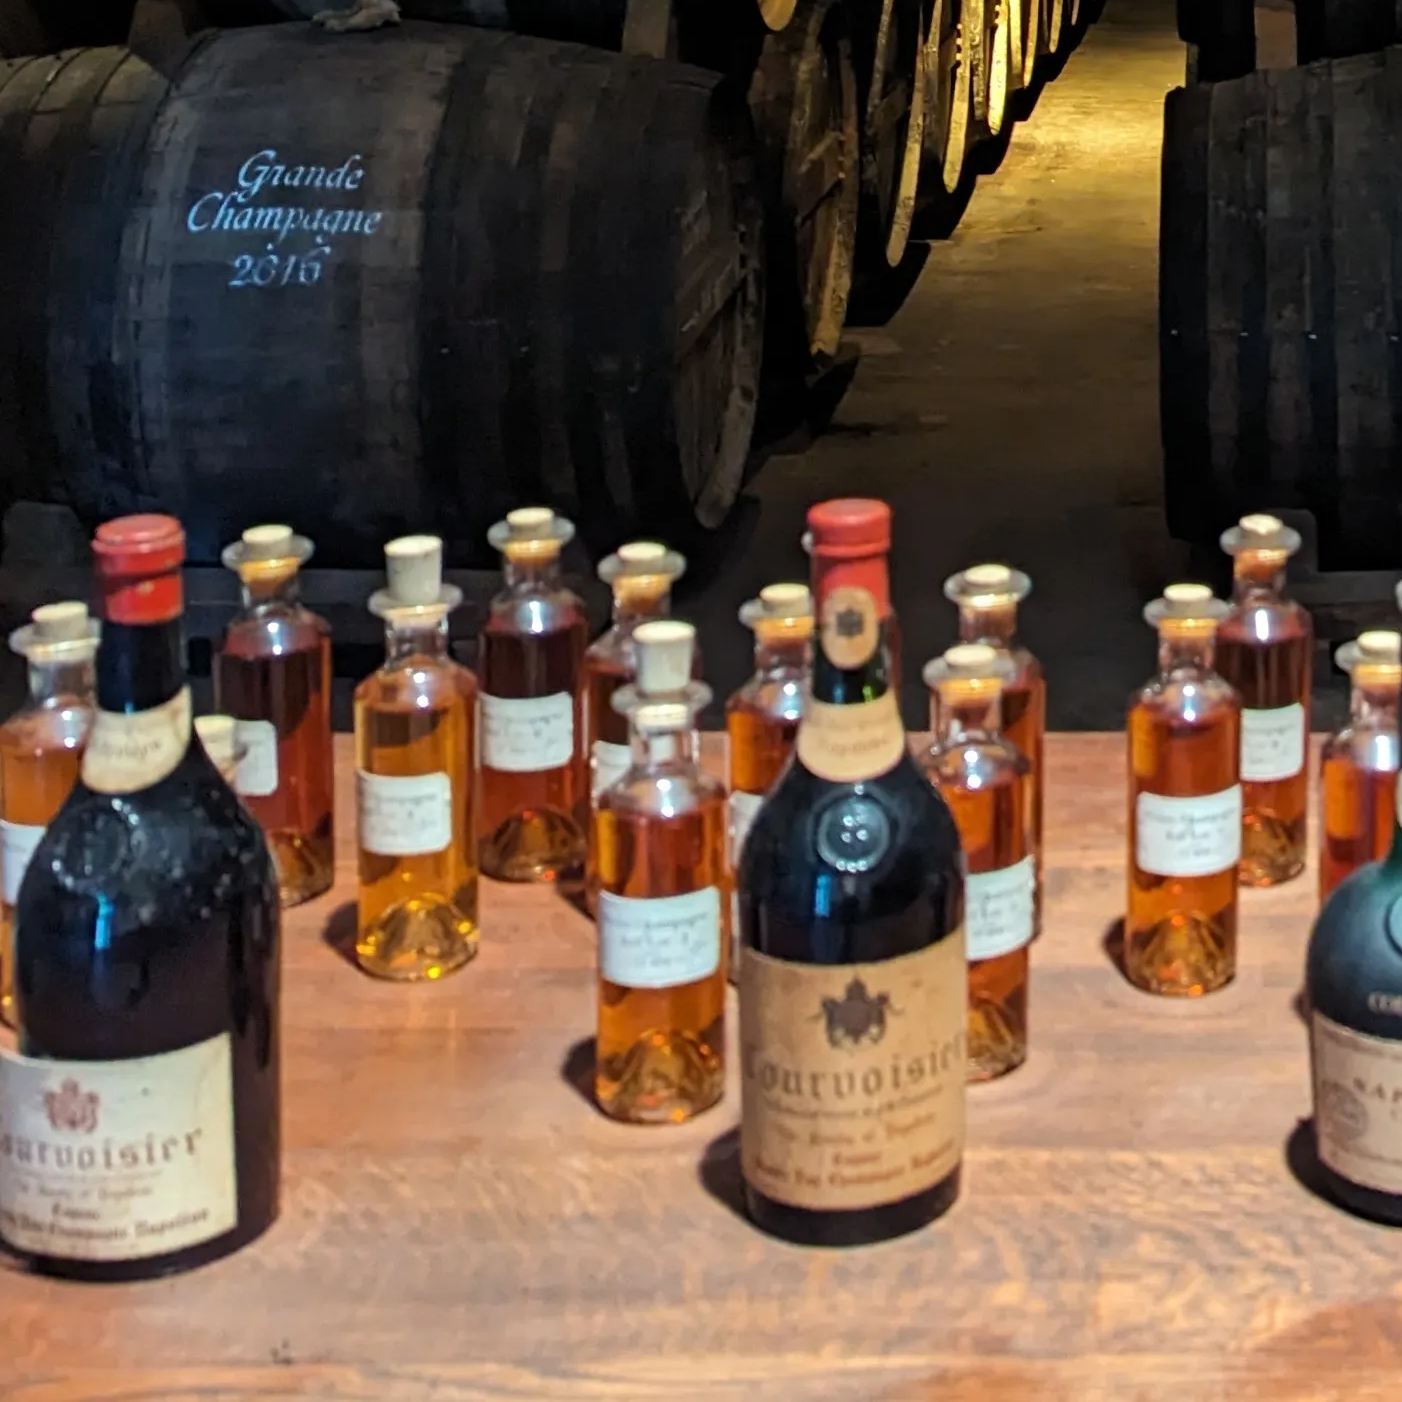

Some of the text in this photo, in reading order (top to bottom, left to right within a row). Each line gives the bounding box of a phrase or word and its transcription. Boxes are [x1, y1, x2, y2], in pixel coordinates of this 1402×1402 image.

[237, 149, 365, 203] Grande
[187, 191, 383, 250] Champagne
[228, 246, 332, 287] 2016
